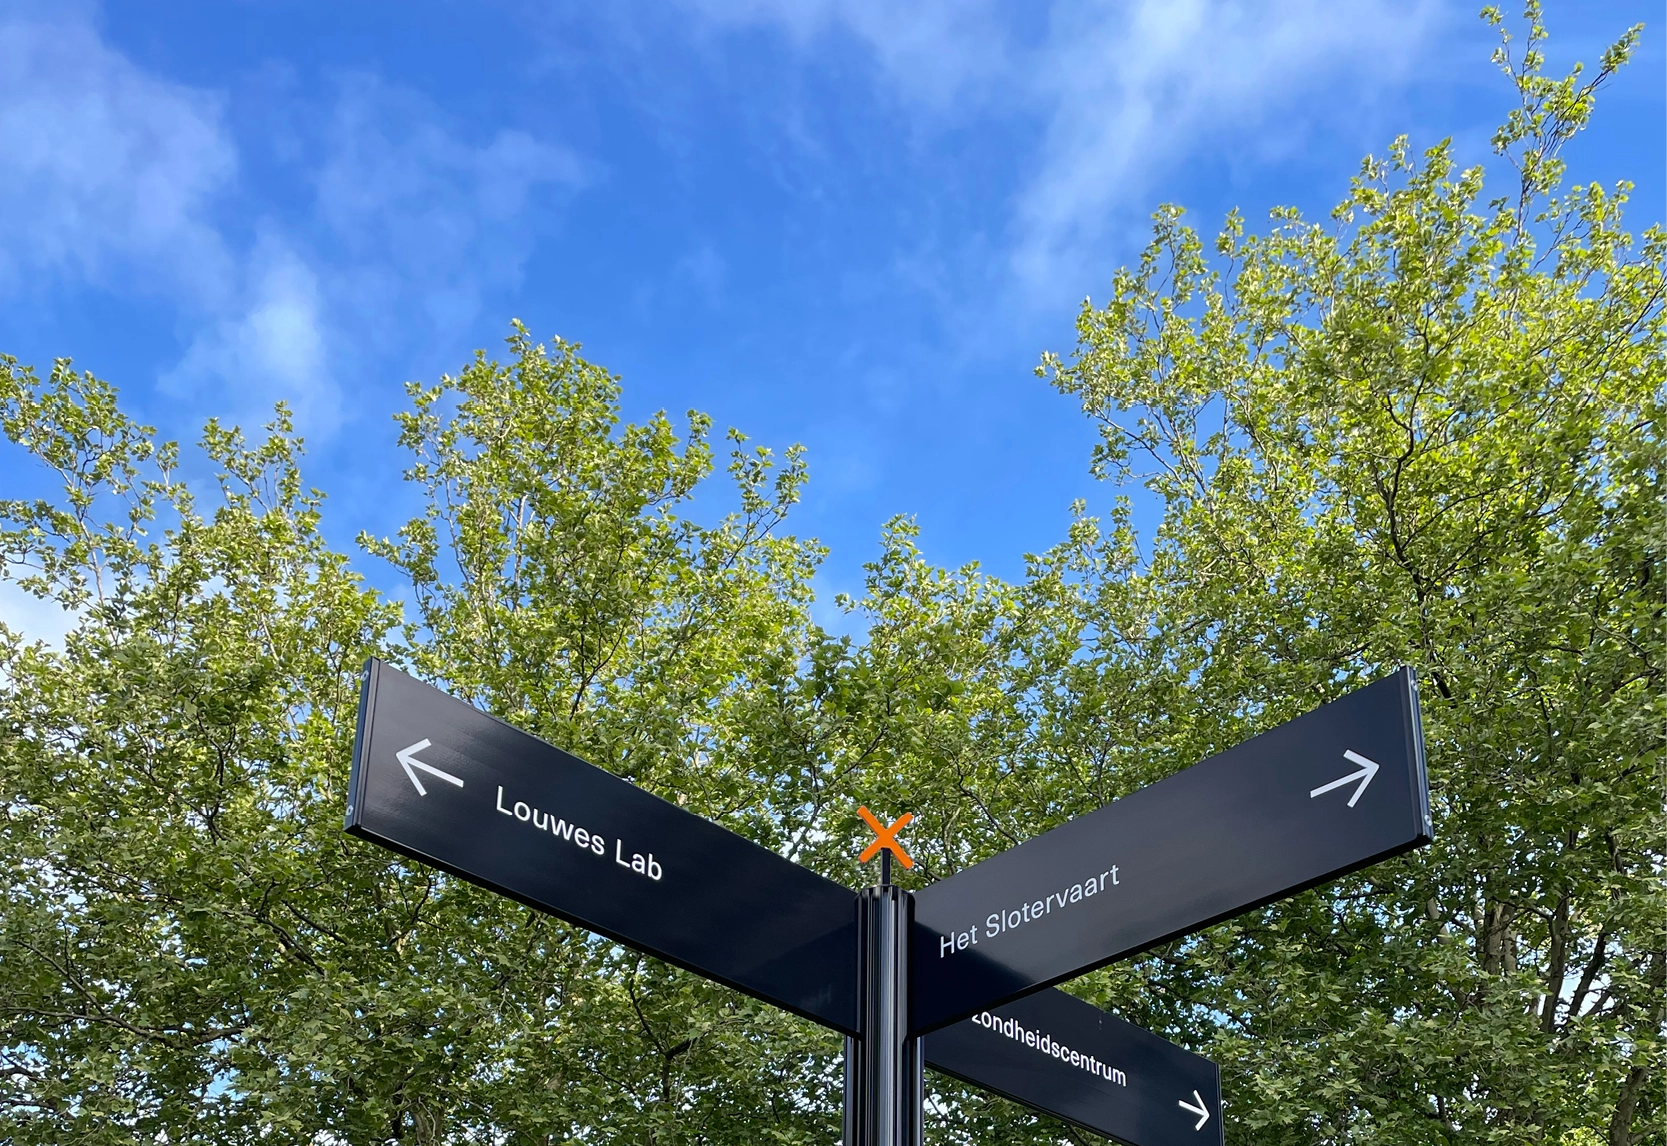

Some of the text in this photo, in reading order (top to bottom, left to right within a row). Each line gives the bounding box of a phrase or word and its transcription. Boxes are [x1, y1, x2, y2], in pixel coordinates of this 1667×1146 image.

[496, 785, 662, 881] Louwes Lab
[940, 864, 1120, 959] Het Slotervaart
